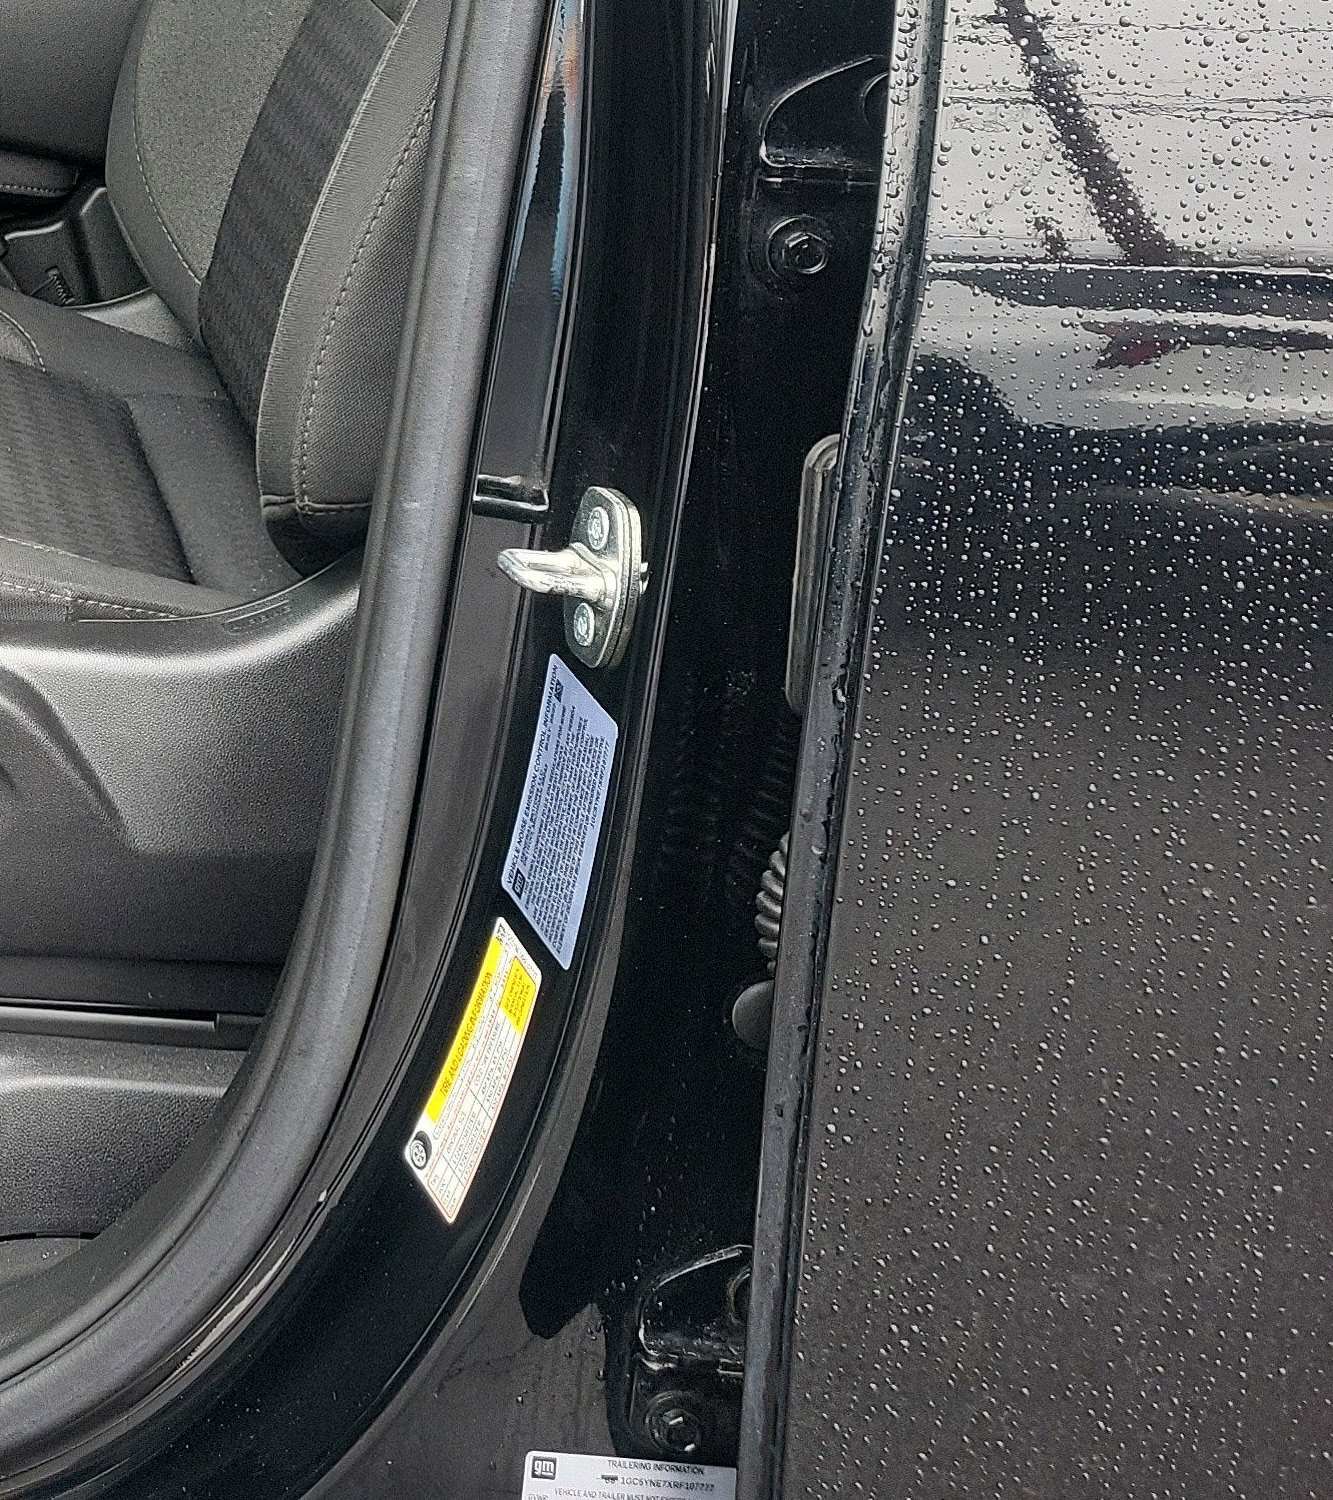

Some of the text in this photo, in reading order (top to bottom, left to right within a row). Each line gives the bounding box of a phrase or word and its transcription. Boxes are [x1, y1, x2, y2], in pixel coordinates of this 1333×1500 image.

[507, 846, 520, 885] VEHICLE
[517, 817, 527, 847] NOISE
[524, 774, 537, 817] EMISSION
[534, 730, 547, 773] CONTROL
[544, 665, 558, 727] INFORMATION
[440, 1076, 452, 1097] TIRE
[448, 1058, 459, 1079] AND
[533, 1459, 555, 1477] gm
[607, 1460, 704, 1475] TRAILERING INFORMATION
[554, 1488, 580, 1497] VEHICLE
[583, 1489, 596, 1498] AND
